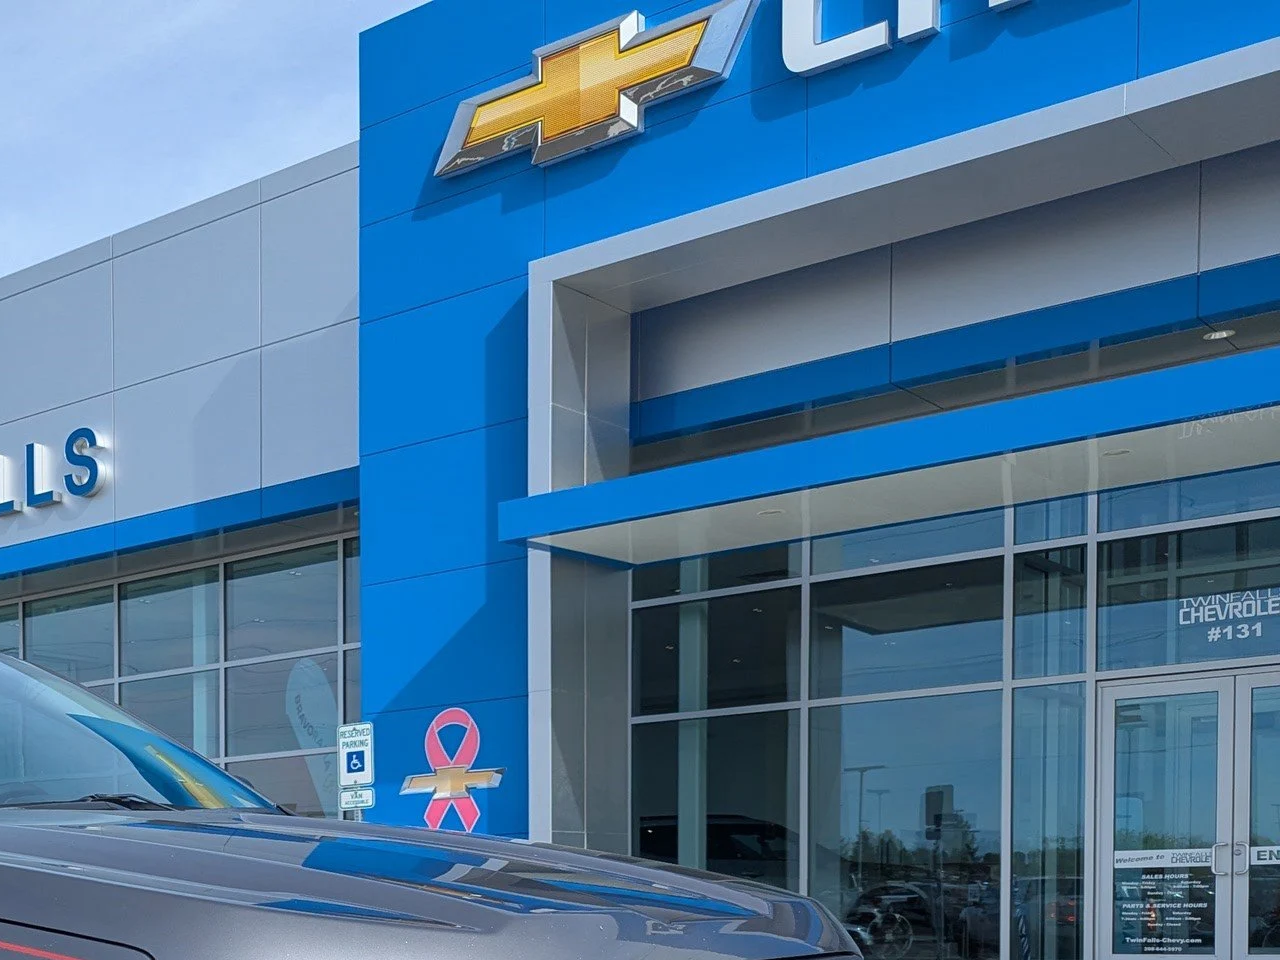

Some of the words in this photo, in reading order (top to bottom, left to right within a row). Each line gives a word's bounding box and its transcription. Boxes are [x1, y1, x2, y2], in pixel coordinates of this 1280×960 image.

[1179, 588, 1280, 608] TWINFALL
[1207, 622, 1262, 642] #131
[340, 728, 370, 739] RESERVED
[341, 739, 369, 749] PARKING
[1115, 855, 1153, 864] Welcome
[1171, 855, 1211, 864] CHEVROLE
